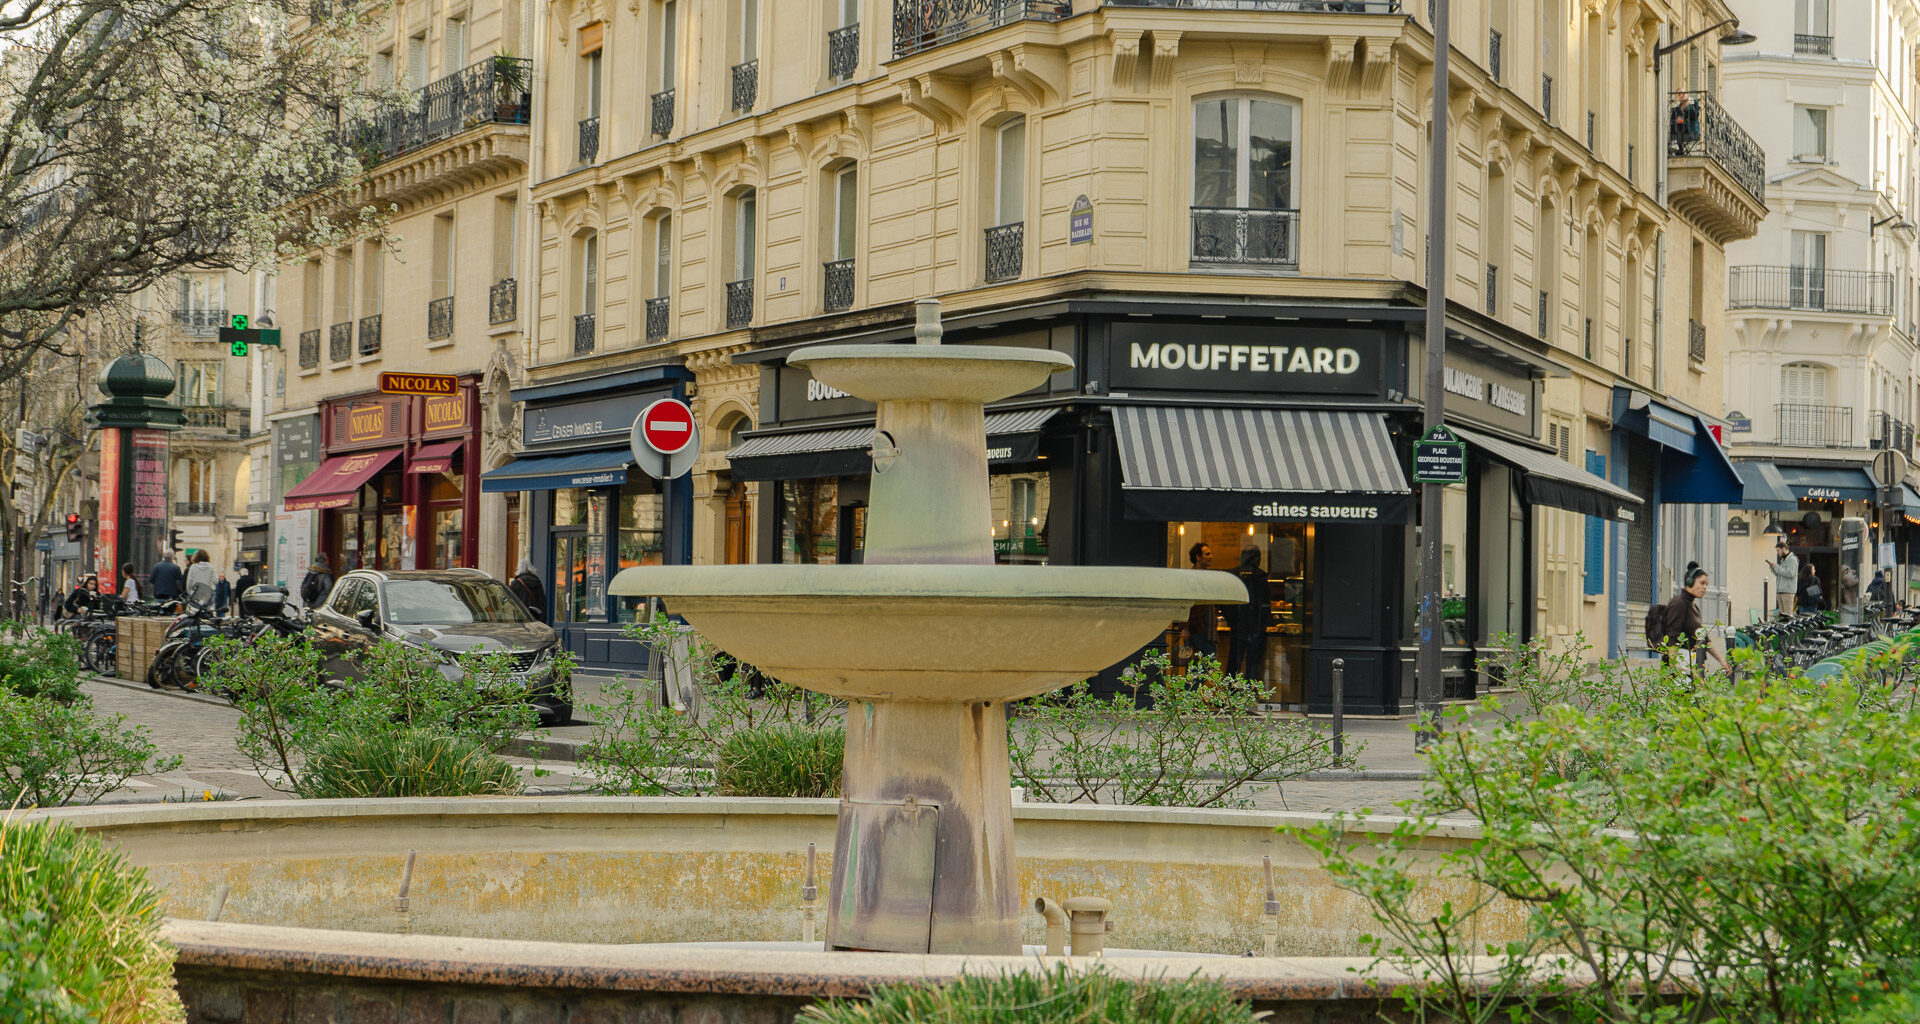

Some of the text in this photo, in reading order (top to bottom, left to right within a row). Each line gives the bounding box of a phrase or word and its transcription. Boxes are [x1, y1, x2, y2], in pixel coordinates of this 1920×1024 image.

[1130, 342, 1361, 375] MOUFFETARD
[389, 377, 450, 392] NICOLAS
[428, 399, 462, 424] NICOLAS
[352, 412, 382, 435] NICOLAS
[986, 447, 1012, 459] aveurs
[1432, 447, 1448, 455] PLACE
[1808, 487, 1840, 498] Café Léa
[1253, 502, 1378, 520] saines saveurs
